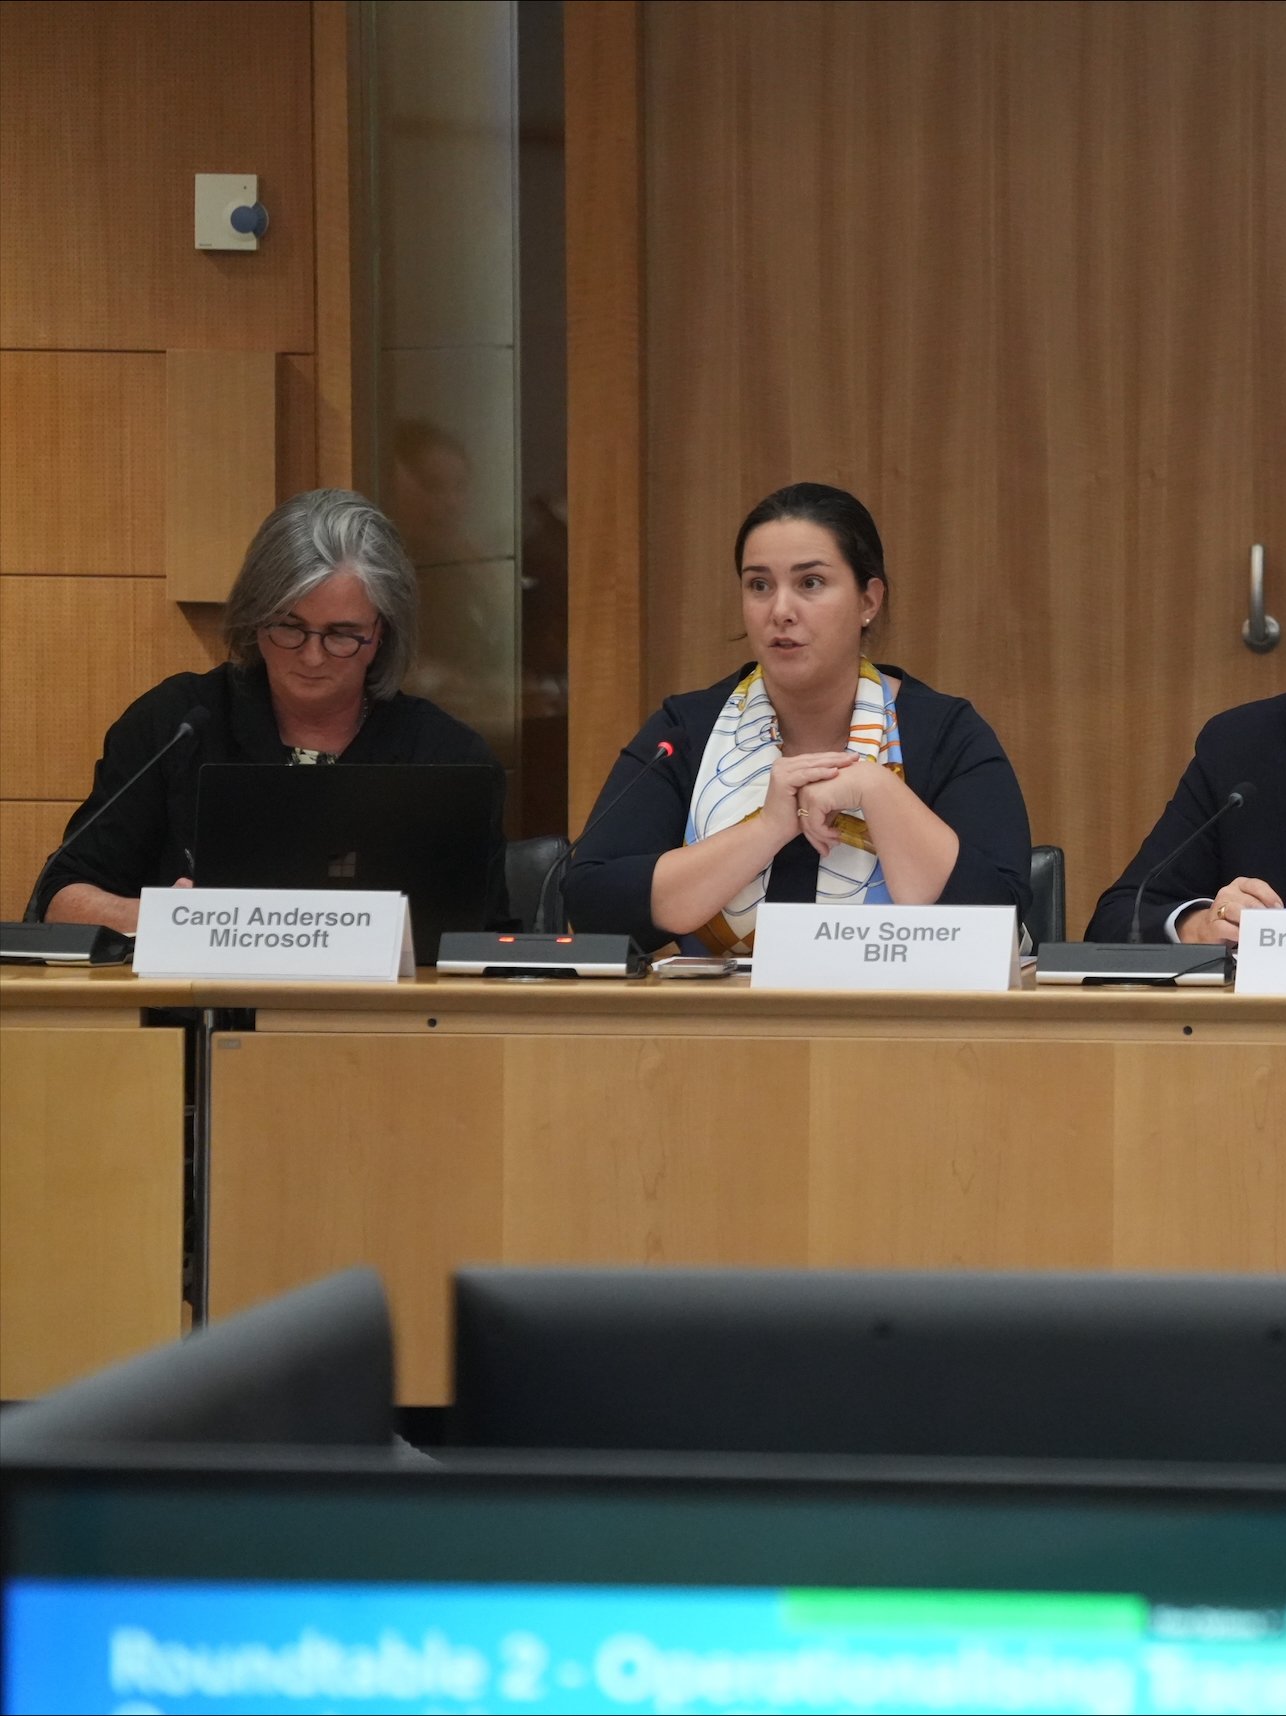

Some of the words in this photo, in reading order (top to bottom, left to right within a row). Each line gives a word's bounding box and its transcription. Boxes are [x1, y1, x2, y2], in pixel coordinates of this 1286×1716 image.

[171, 906, 239, 926] Carol
[247, 907, 371, 927] Anderson
[209, 929, 329, 948] Microsoft
[814, 922, 870, 940] Alev
[878, 922, 961, 941] Somer
[863, 943, 908, 962] BIR
[110, 1625, 491, 1698] Roundtable
[501, 1629, 549, 1701] 2
